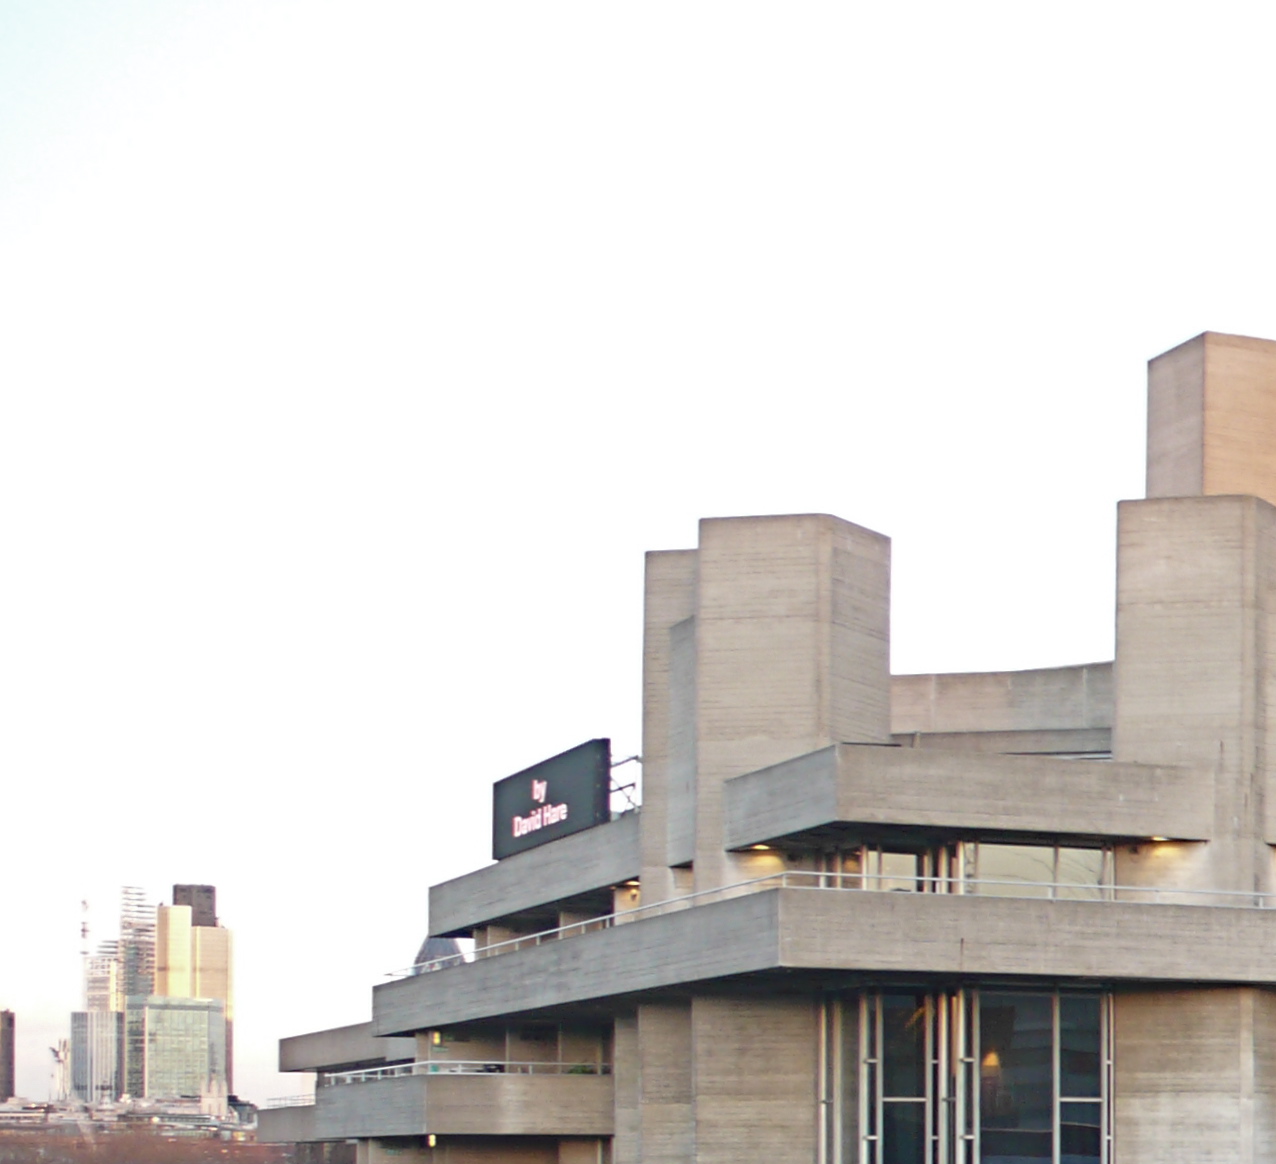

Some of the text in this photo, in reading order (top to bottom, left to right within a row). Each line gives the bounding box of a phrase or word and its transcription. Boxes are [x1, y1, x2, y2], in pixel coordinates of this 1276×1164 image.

[531, 779, 548, 803] by
[511, 803, 568, 838] David Hare
